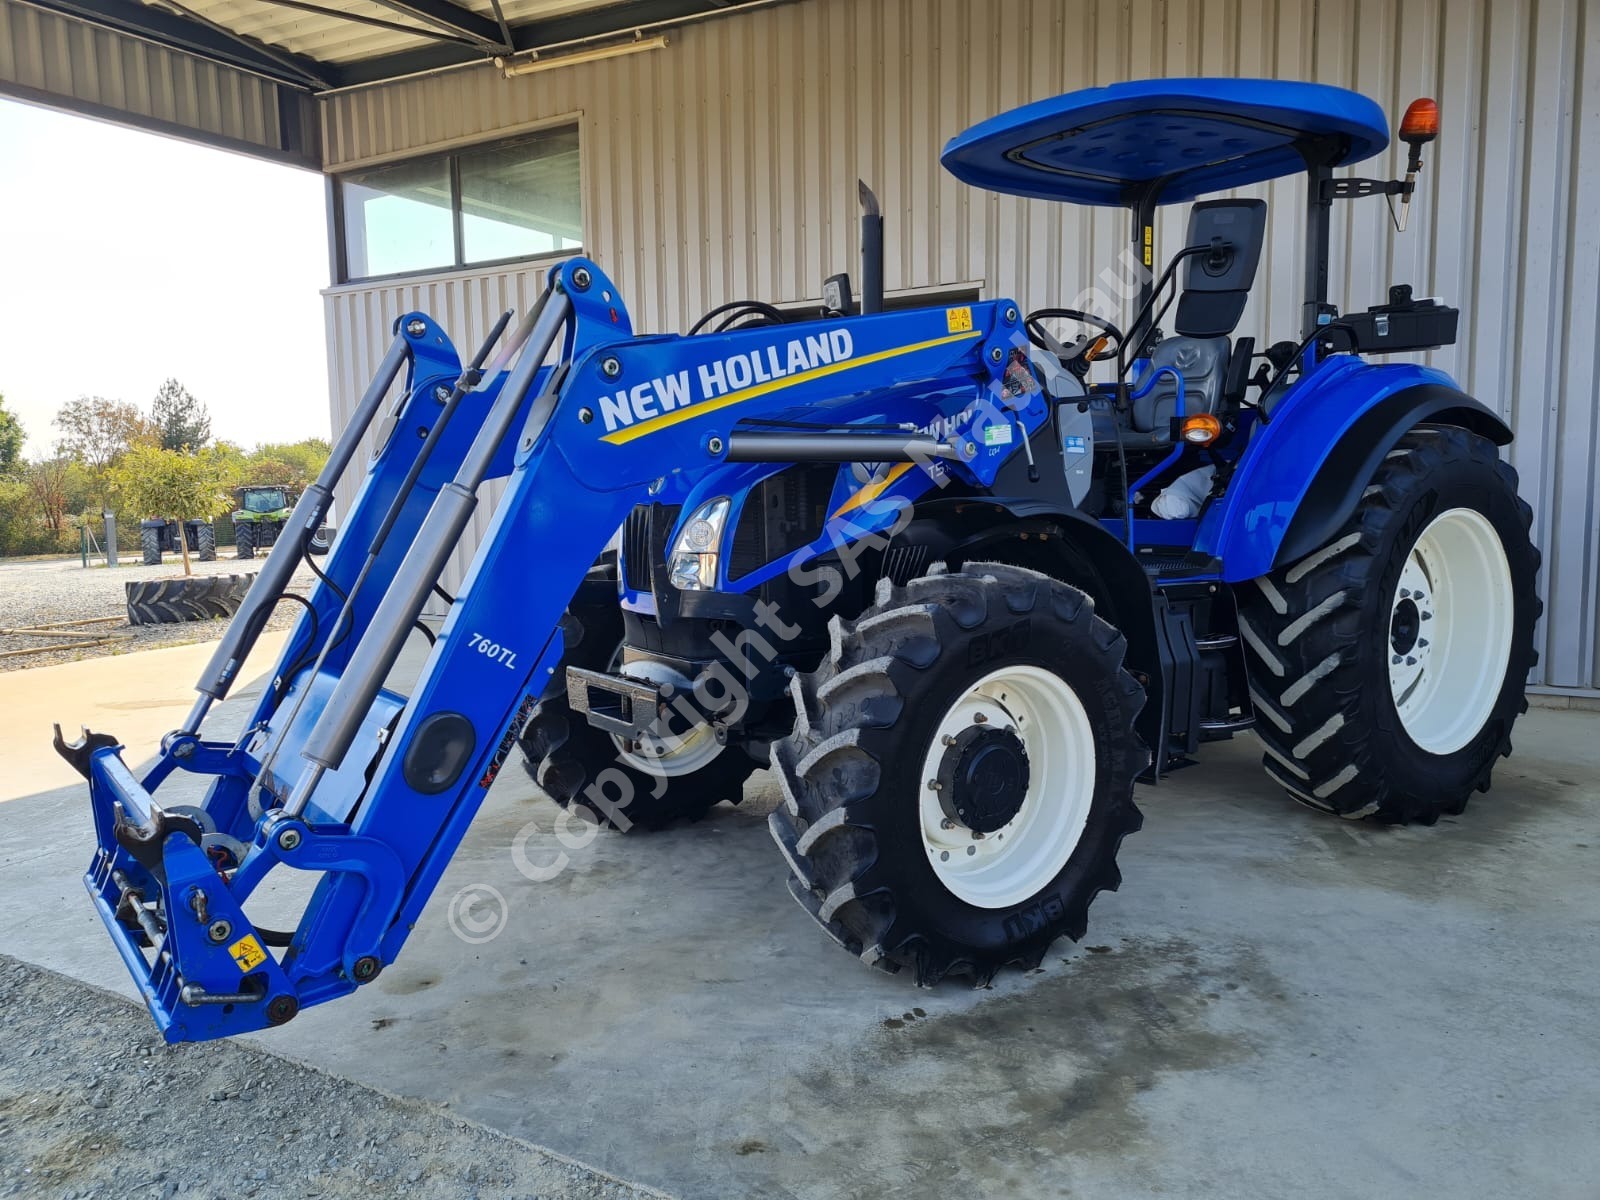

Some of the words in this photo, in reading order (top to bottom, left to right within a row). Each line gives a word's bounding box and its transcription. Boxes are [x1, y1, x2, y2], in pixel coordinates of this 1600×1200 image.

[598, 369, 691, 432] NEW
[698, 328, 854, 399] HOLLAND
[468, 632, 516, 670] 760TL
